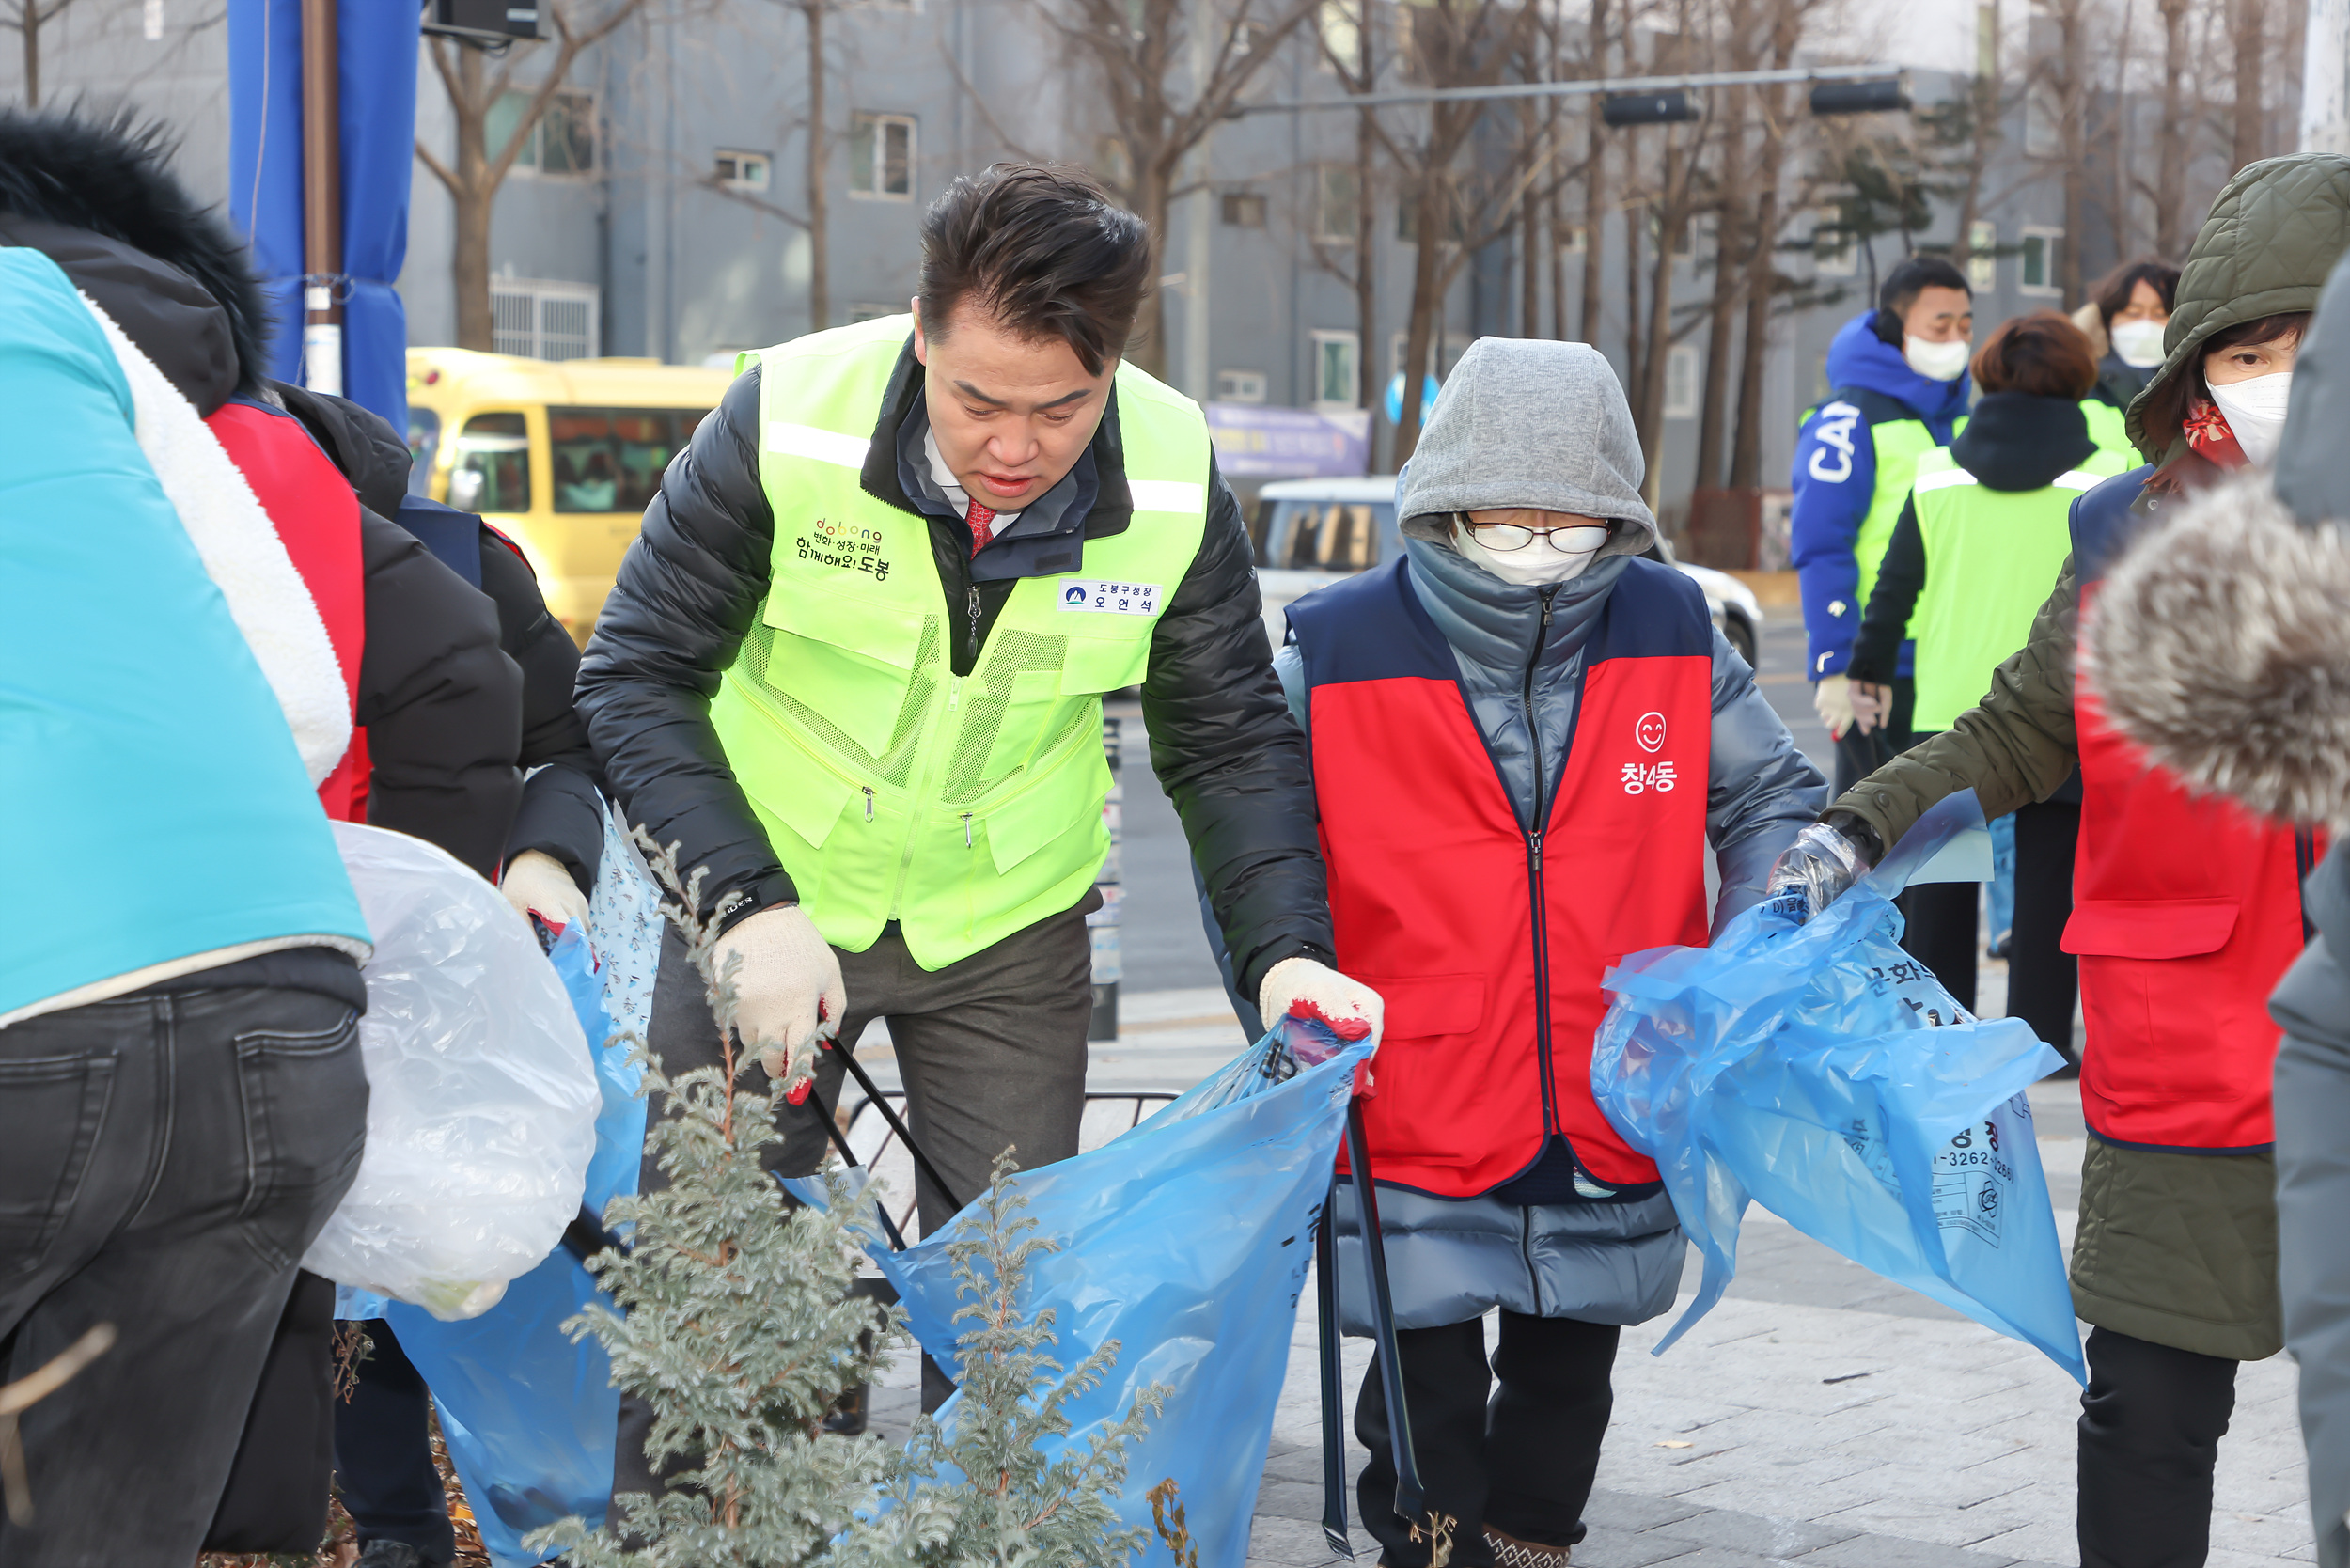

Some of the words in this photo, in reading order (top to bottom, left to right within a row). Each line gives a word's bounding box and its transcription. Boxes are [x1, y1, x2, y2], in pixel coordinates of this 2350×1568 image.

[816, 517, 882, 544] dobong
[857, 556, 890, 582] 도봉
[1099, 584, 1152, 597] 도봉구청장
[1621, 760, 1678, 795] 창4동
